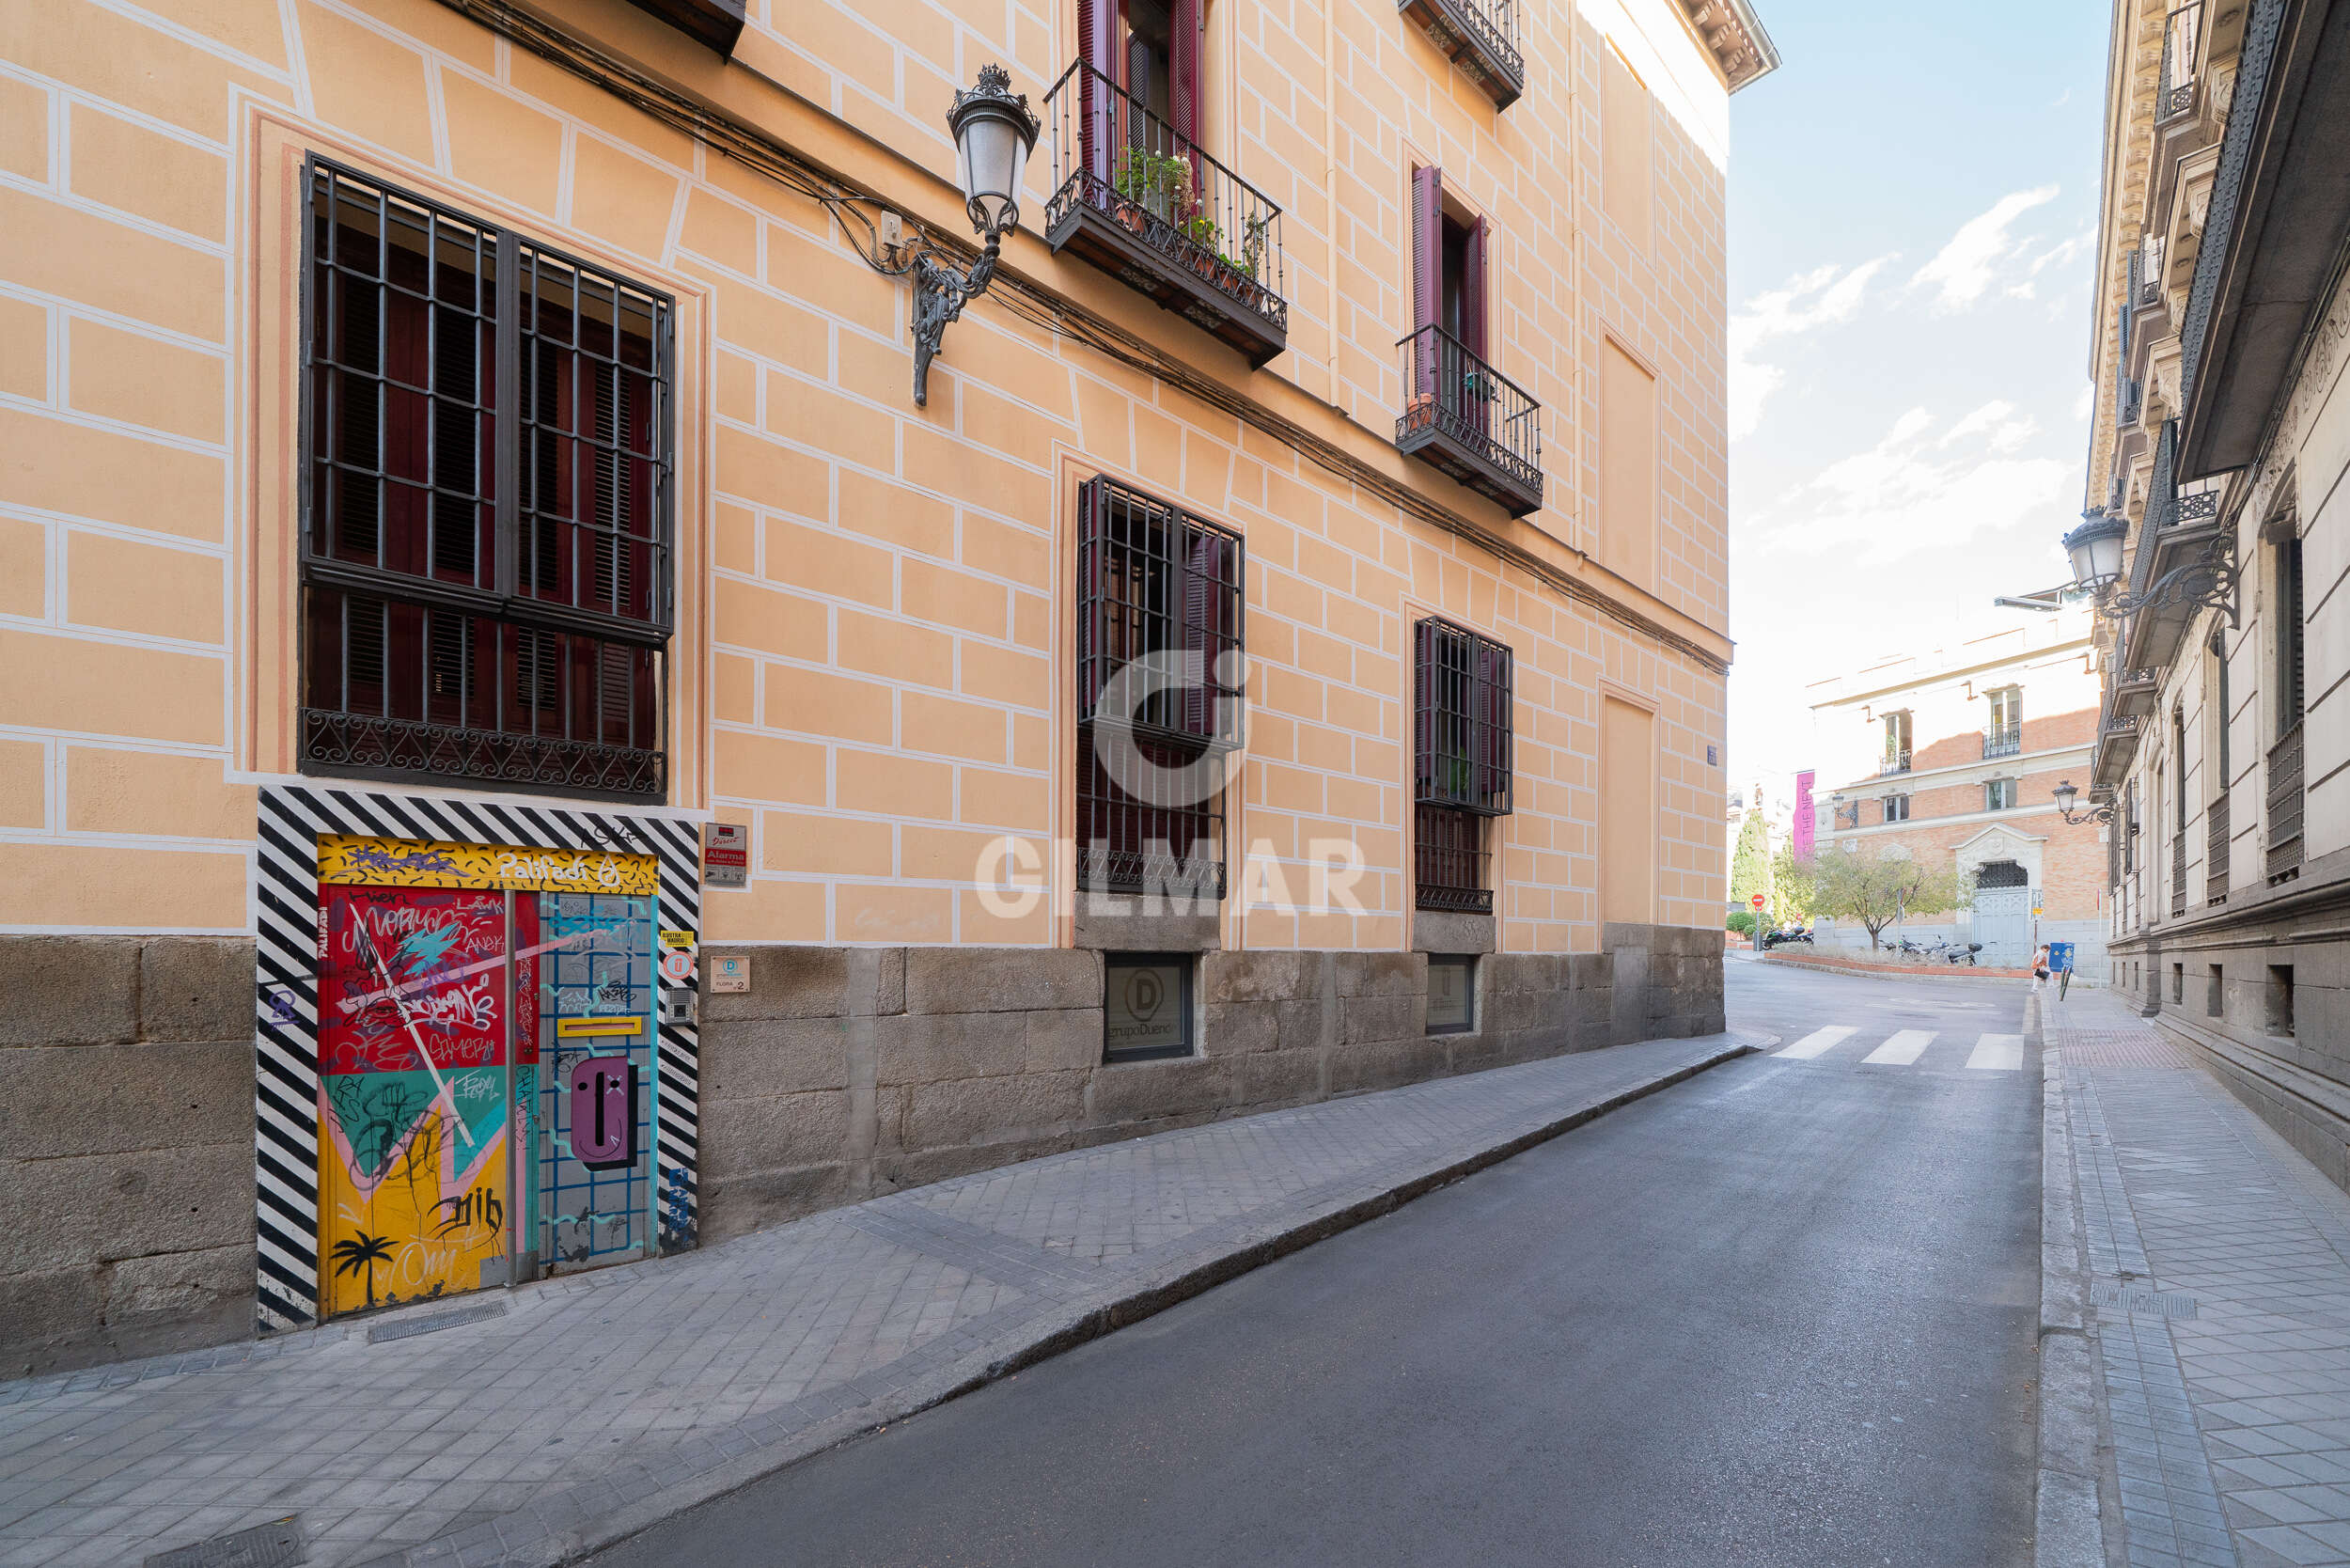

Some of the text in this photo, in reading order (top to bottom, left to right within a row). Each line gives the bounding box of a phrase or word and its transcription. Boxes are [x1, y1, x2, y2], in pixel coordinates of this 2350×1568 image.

[1802, 813, 1812, 835] THE
[708, 850, 744, 860] Alarma
[318, 906, 328, 959] PALIFADI
[737, 981, 744, 990] 2
[1136, 979, 1157, 1010] D
